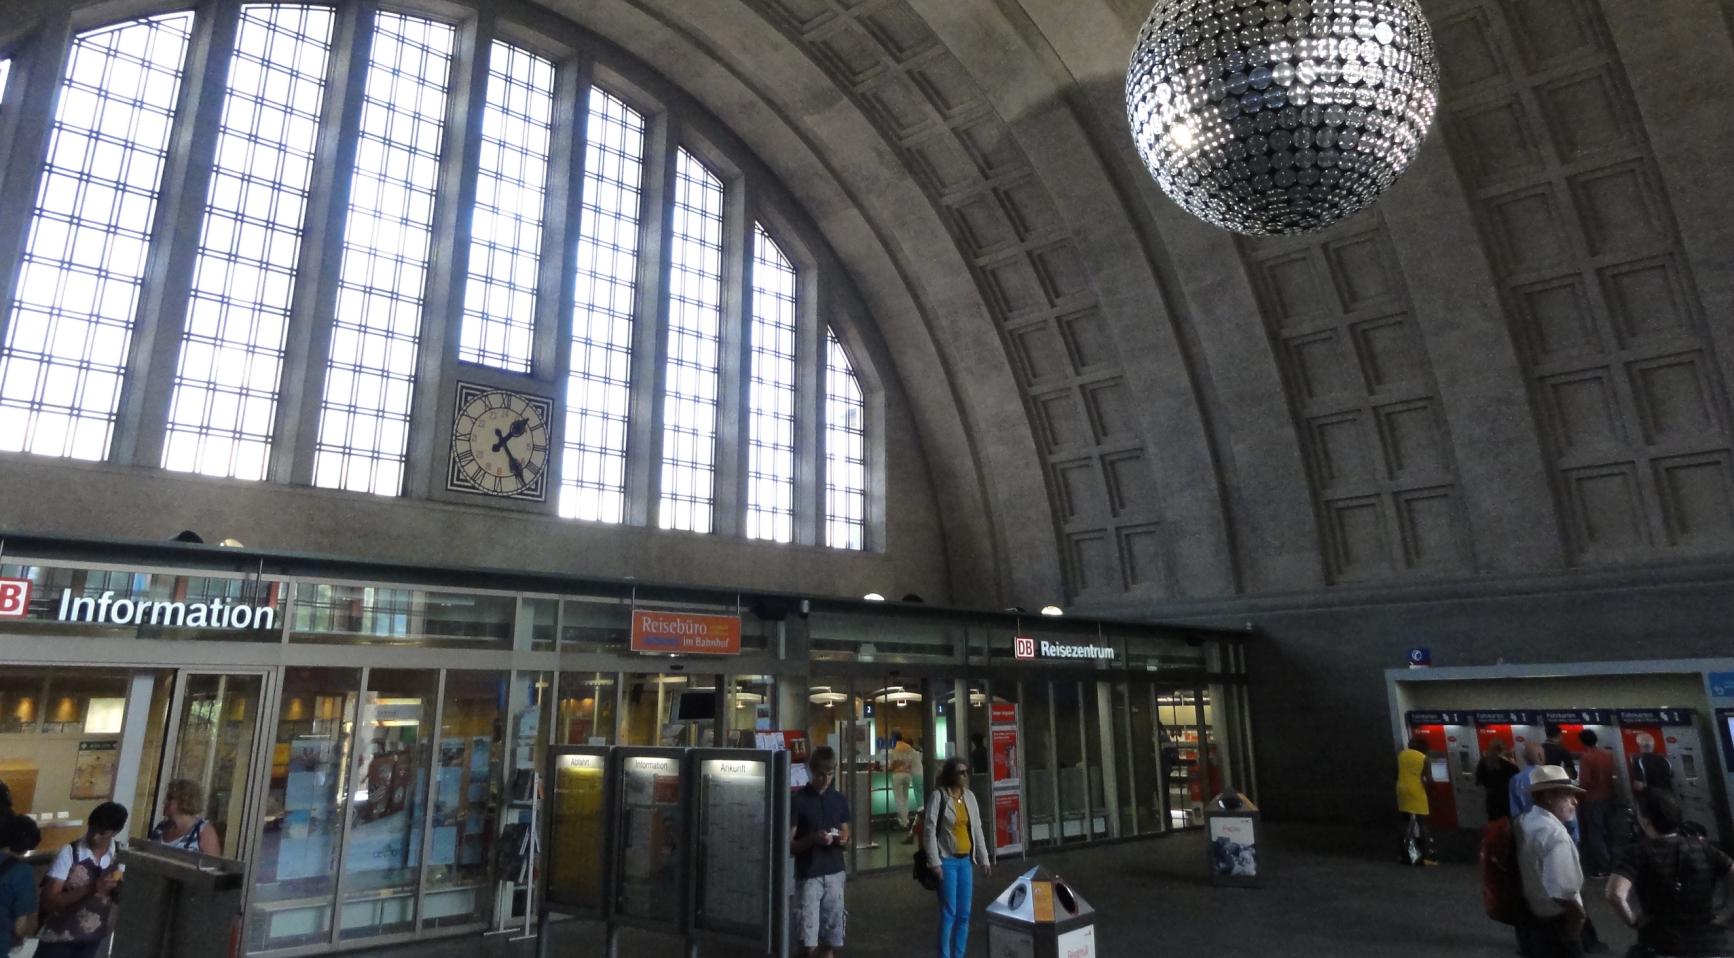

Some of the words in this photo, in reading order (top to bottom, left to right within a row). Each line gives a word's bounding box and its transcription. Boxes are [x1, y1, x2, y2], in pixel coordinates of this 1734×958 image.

[58, 588, 275, 630] Information
[642, 616, 708, 635] Reisebüro
[695, 637, 730, 648] Bahnhof
[1018, 639, 1034, 656] DB
[1041, 640, 1115, 659] Reisezentrum
[635, 759, 668, 770] Information
[720, 763, 746, 773] Ankunft
